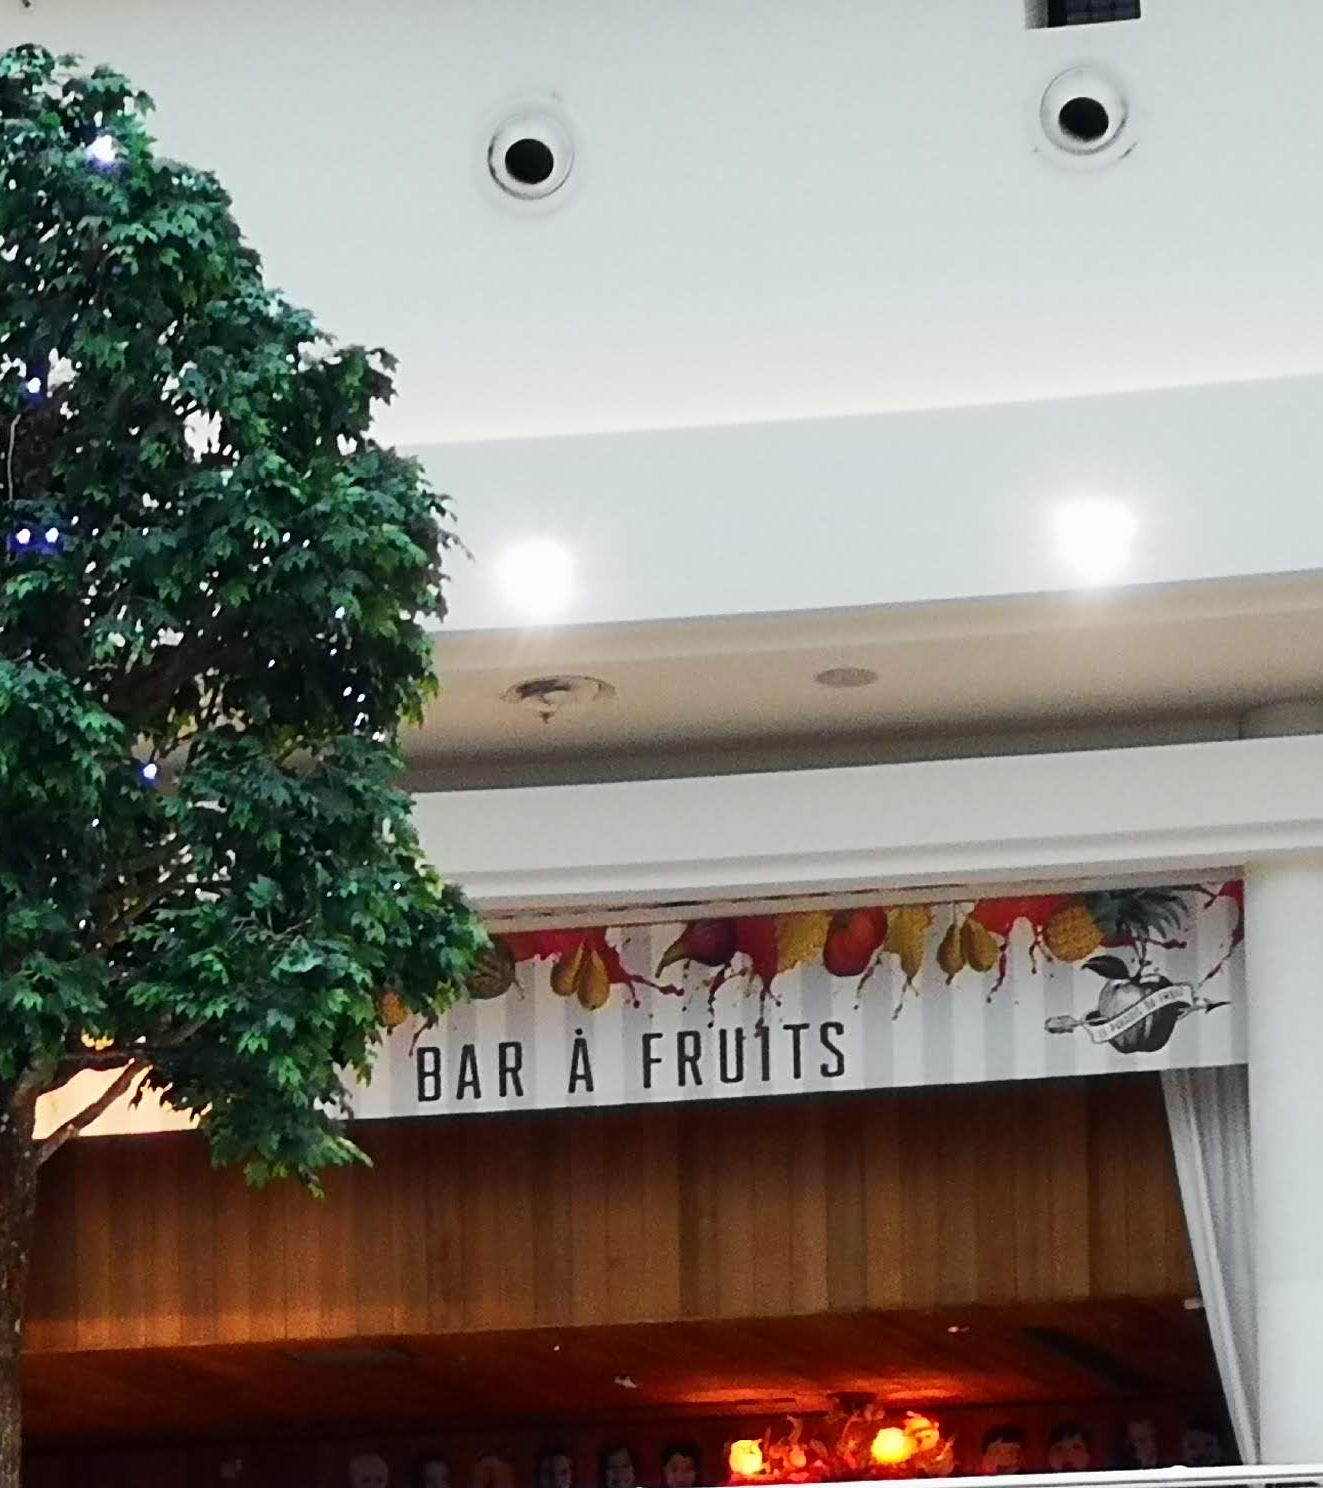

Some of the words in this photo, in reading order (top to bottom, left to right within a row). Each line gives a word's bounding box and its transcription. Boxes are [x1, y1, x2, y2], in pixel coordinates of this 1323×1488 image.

[416, 1041, 523, 1103] BAR
[568, 1027, 594, 1094] À
[642, 1021, 846, 1089] FRUITS
